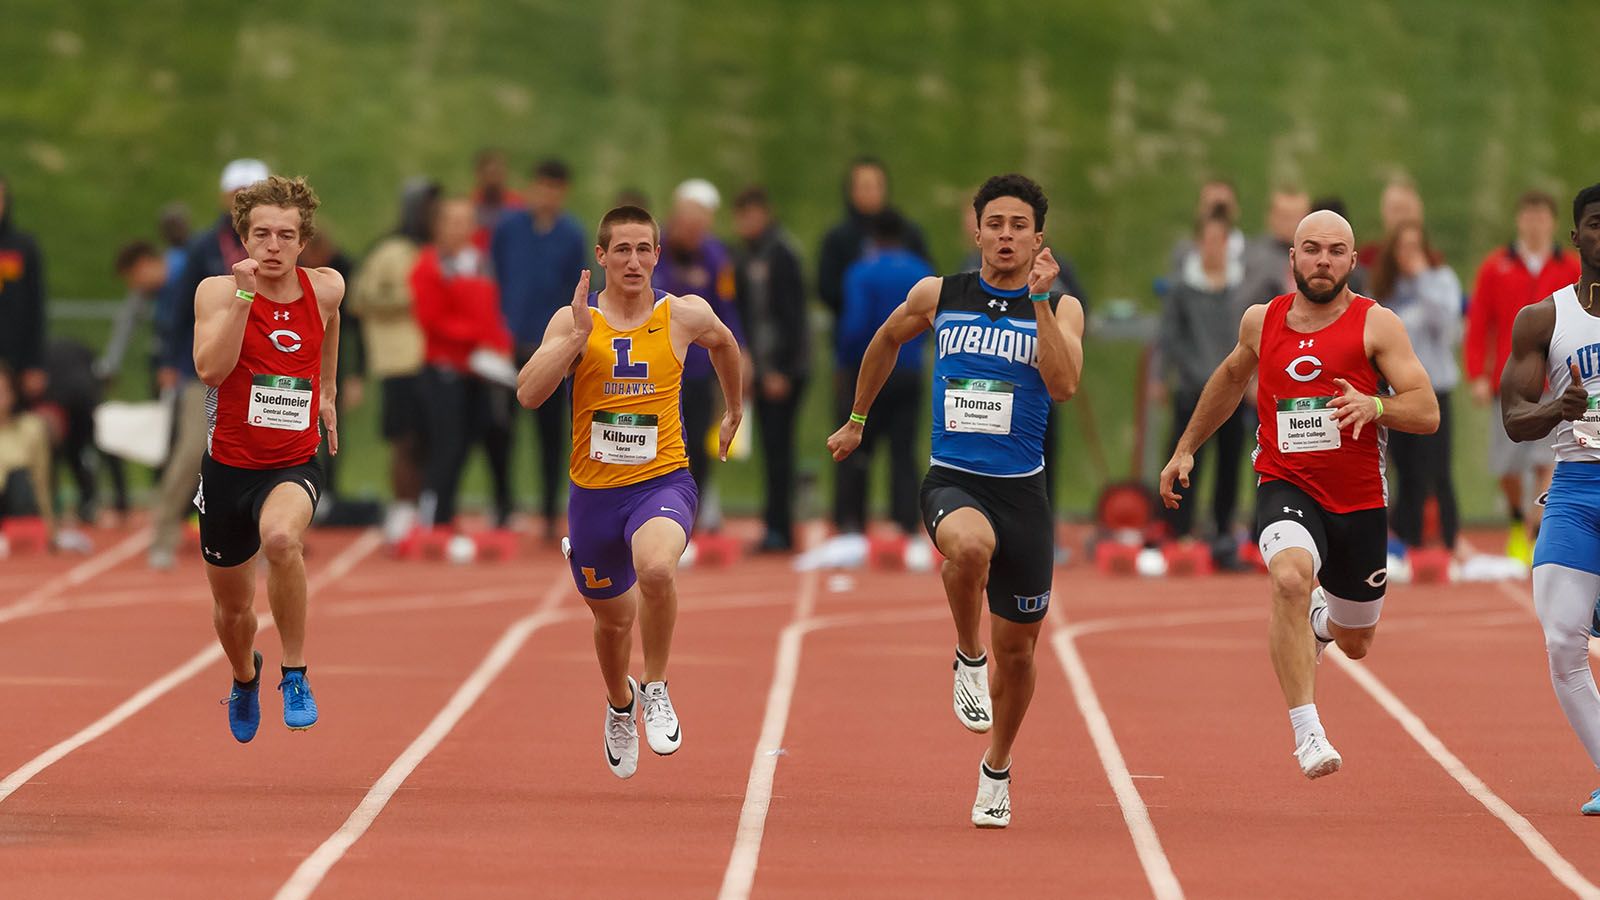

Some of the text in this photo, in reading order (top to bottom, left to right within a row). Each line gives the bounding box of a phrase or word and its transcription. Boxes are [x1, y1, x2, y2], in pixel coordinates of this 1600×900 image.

[612, 337, 649, 380] L
[604, 382, 656, 395] DUHAWKS
[254, 392, 310, 408] Suedmeier
[953, 396, 1002, 411] Thomas
[262, 407, 300, 418] Central College
[964, 411, 989, 420] Dubuque
[1289, 415, 1323, 430] Neeld
[602, 429, 647, 446] Kilburg
[580, 566, 614, 589] L
